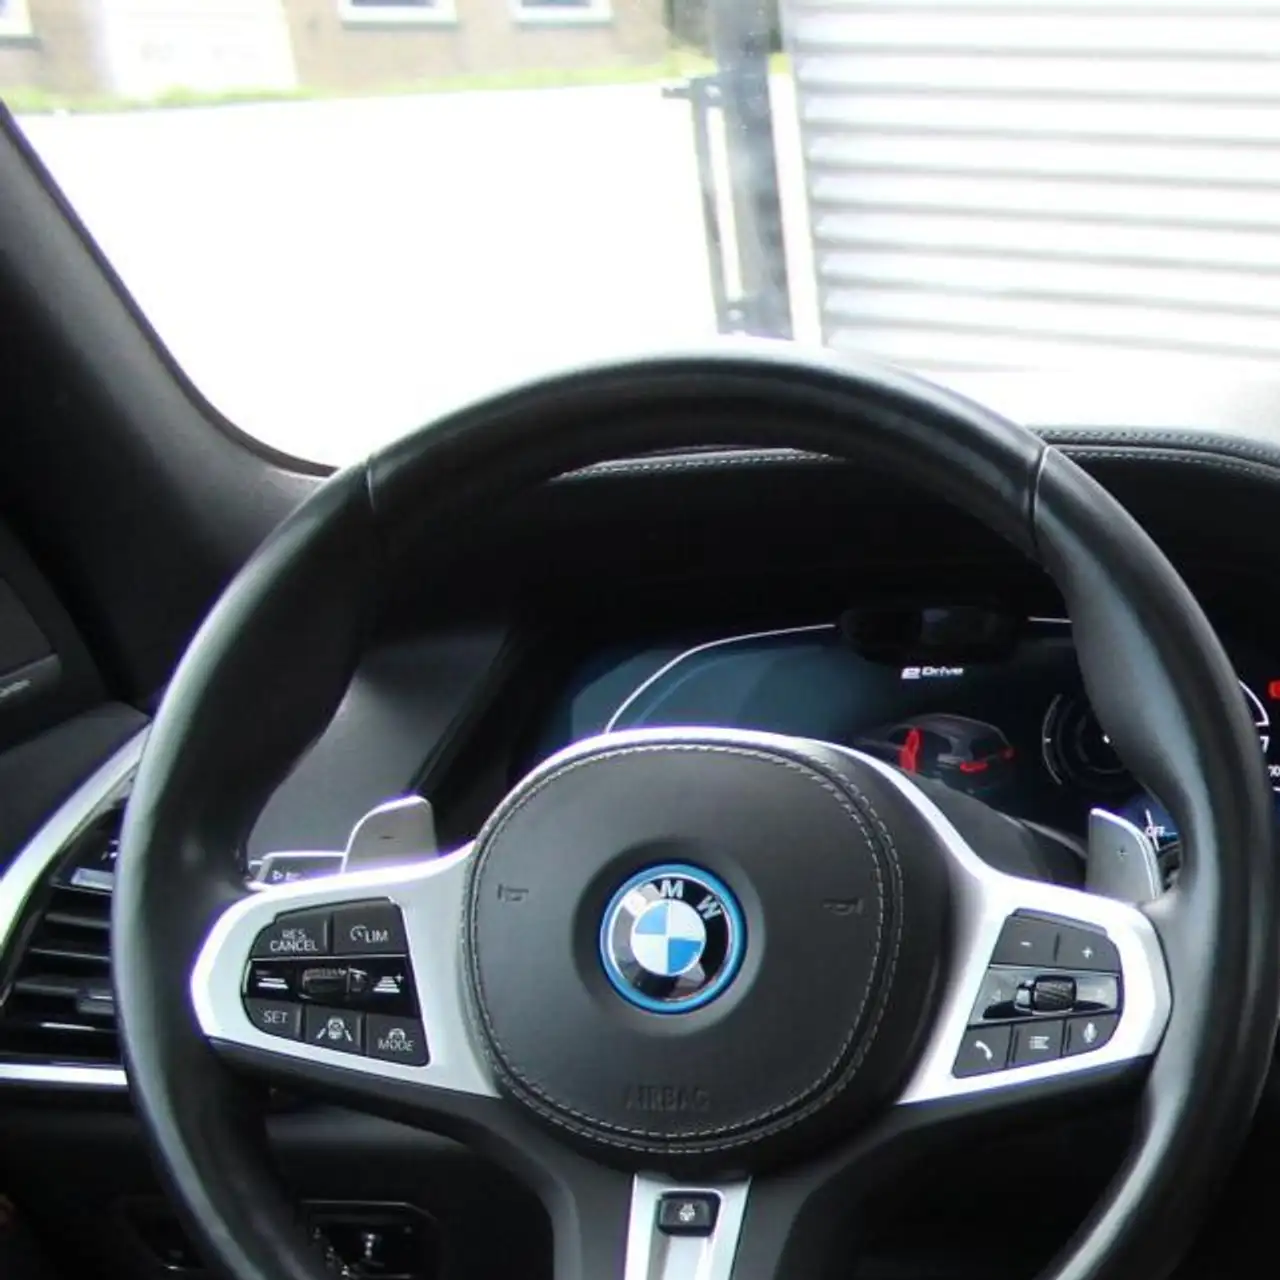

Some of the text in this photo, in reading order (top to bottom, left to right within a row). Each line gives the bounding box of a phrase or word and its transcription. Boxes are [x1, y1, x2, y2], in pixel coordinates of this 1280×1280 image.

[366, 929, 389, 943] LIM
[270, 940, 318, 951] CANCEL
[263, 1010, 289, 1024] SET
